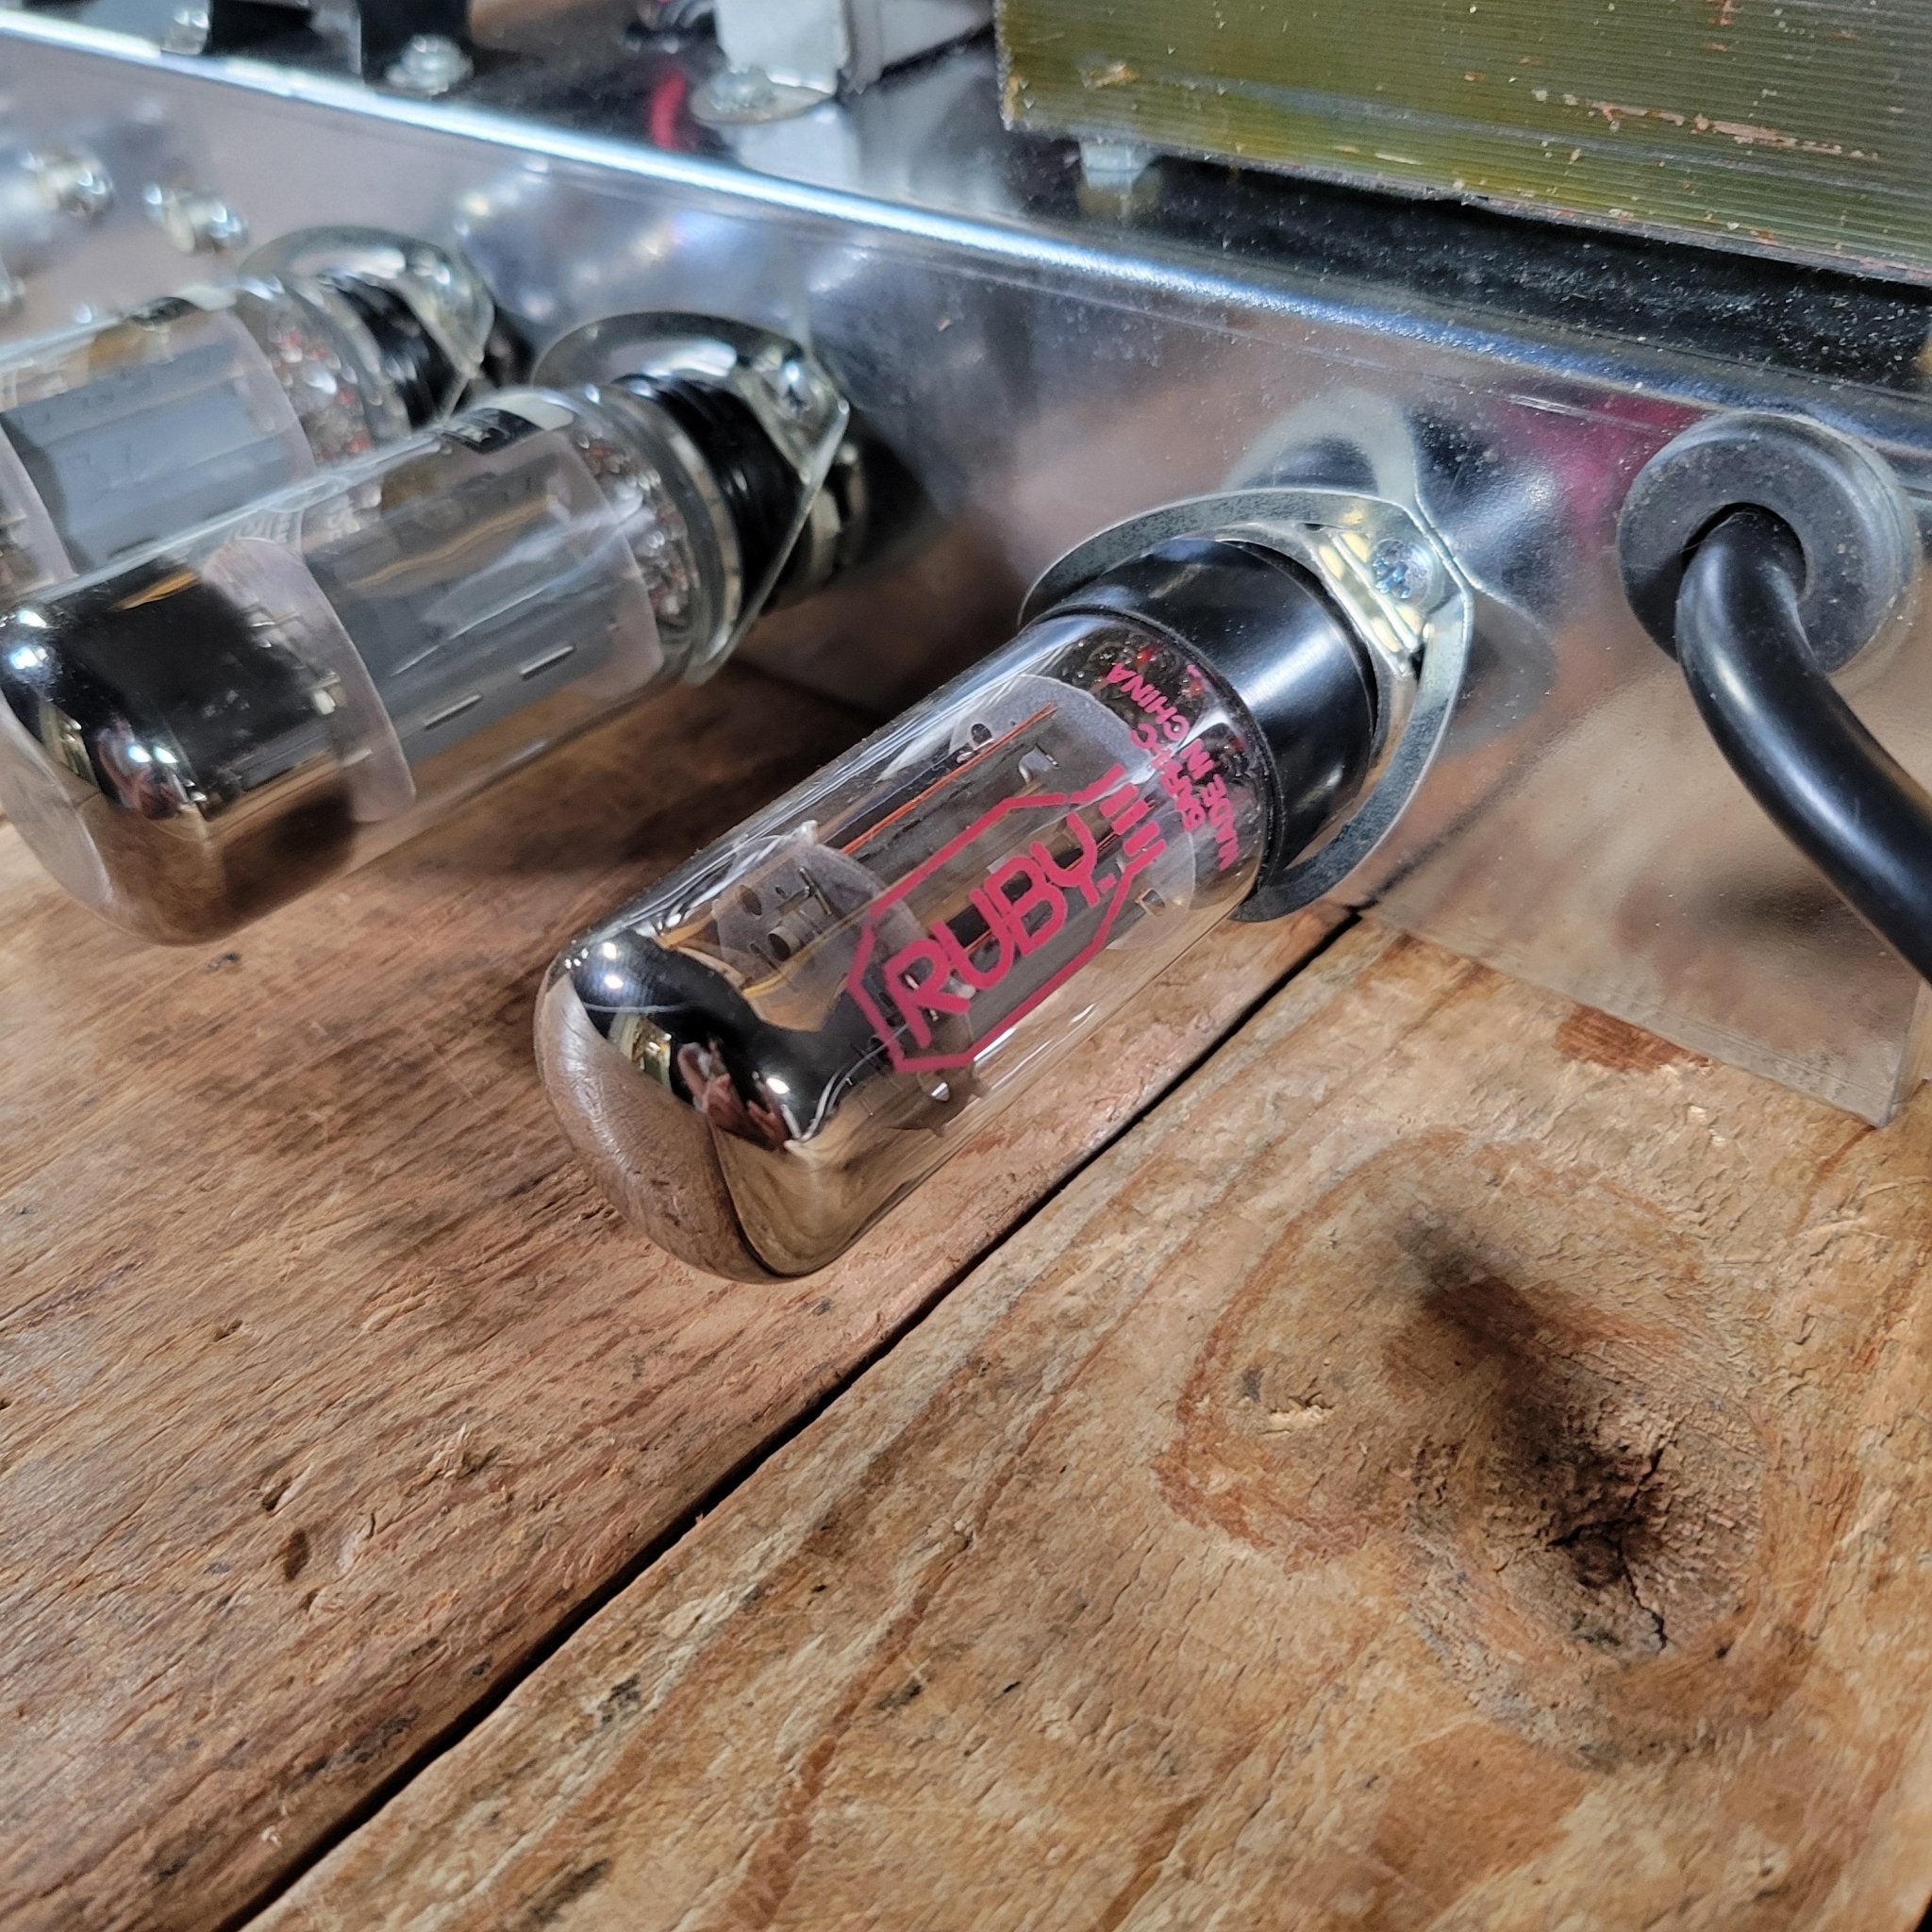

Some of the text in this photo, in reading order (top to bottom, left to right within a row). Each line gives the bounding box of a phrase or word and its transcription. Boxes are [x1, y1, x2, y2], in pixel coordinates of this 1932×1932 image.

[1106, 662, 1240, 872] MADE IN CHINA
[882, 812, 1101, 1048] RUBY
